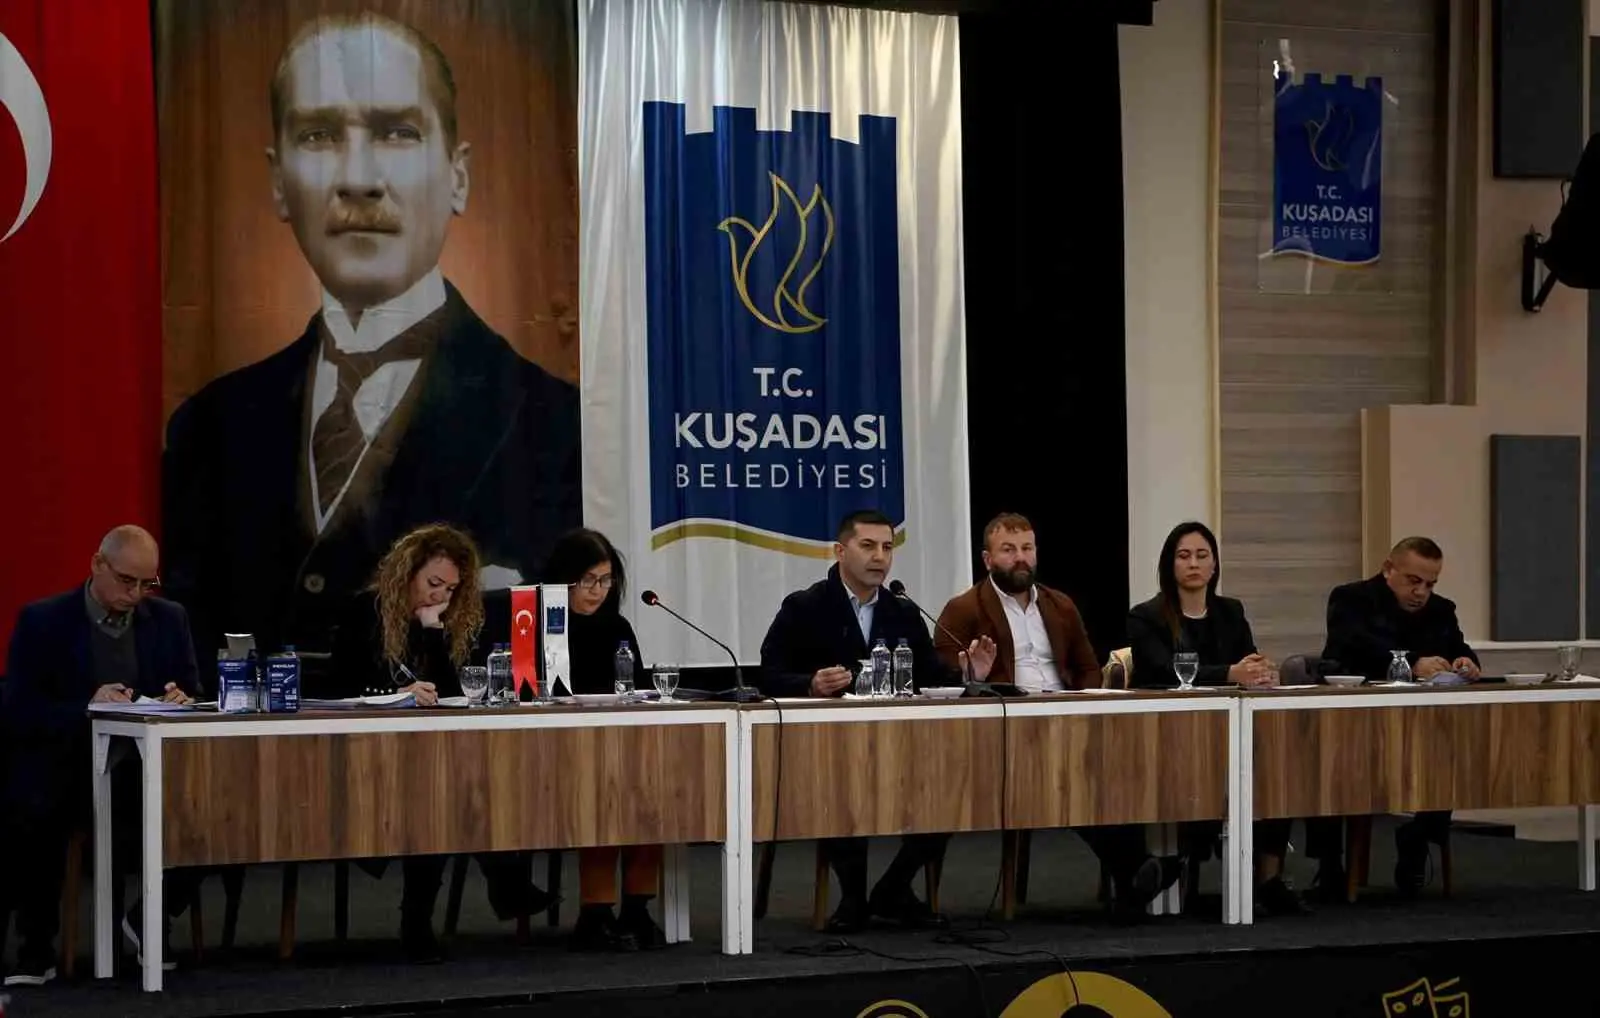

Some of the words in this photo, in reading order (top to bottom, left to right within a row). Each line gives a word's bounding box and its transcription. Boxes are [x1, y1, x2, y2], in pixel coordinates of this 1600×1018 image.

[1317, 184, 1342, 200] T.C.
[1282, 203, 1373, 224] KUŞADASI
[753, 367, 814, 398] T.C.
[675, 412, 887, 453] KUŞADASI
[676, 458, 887, 489] BELEDİYESİ
